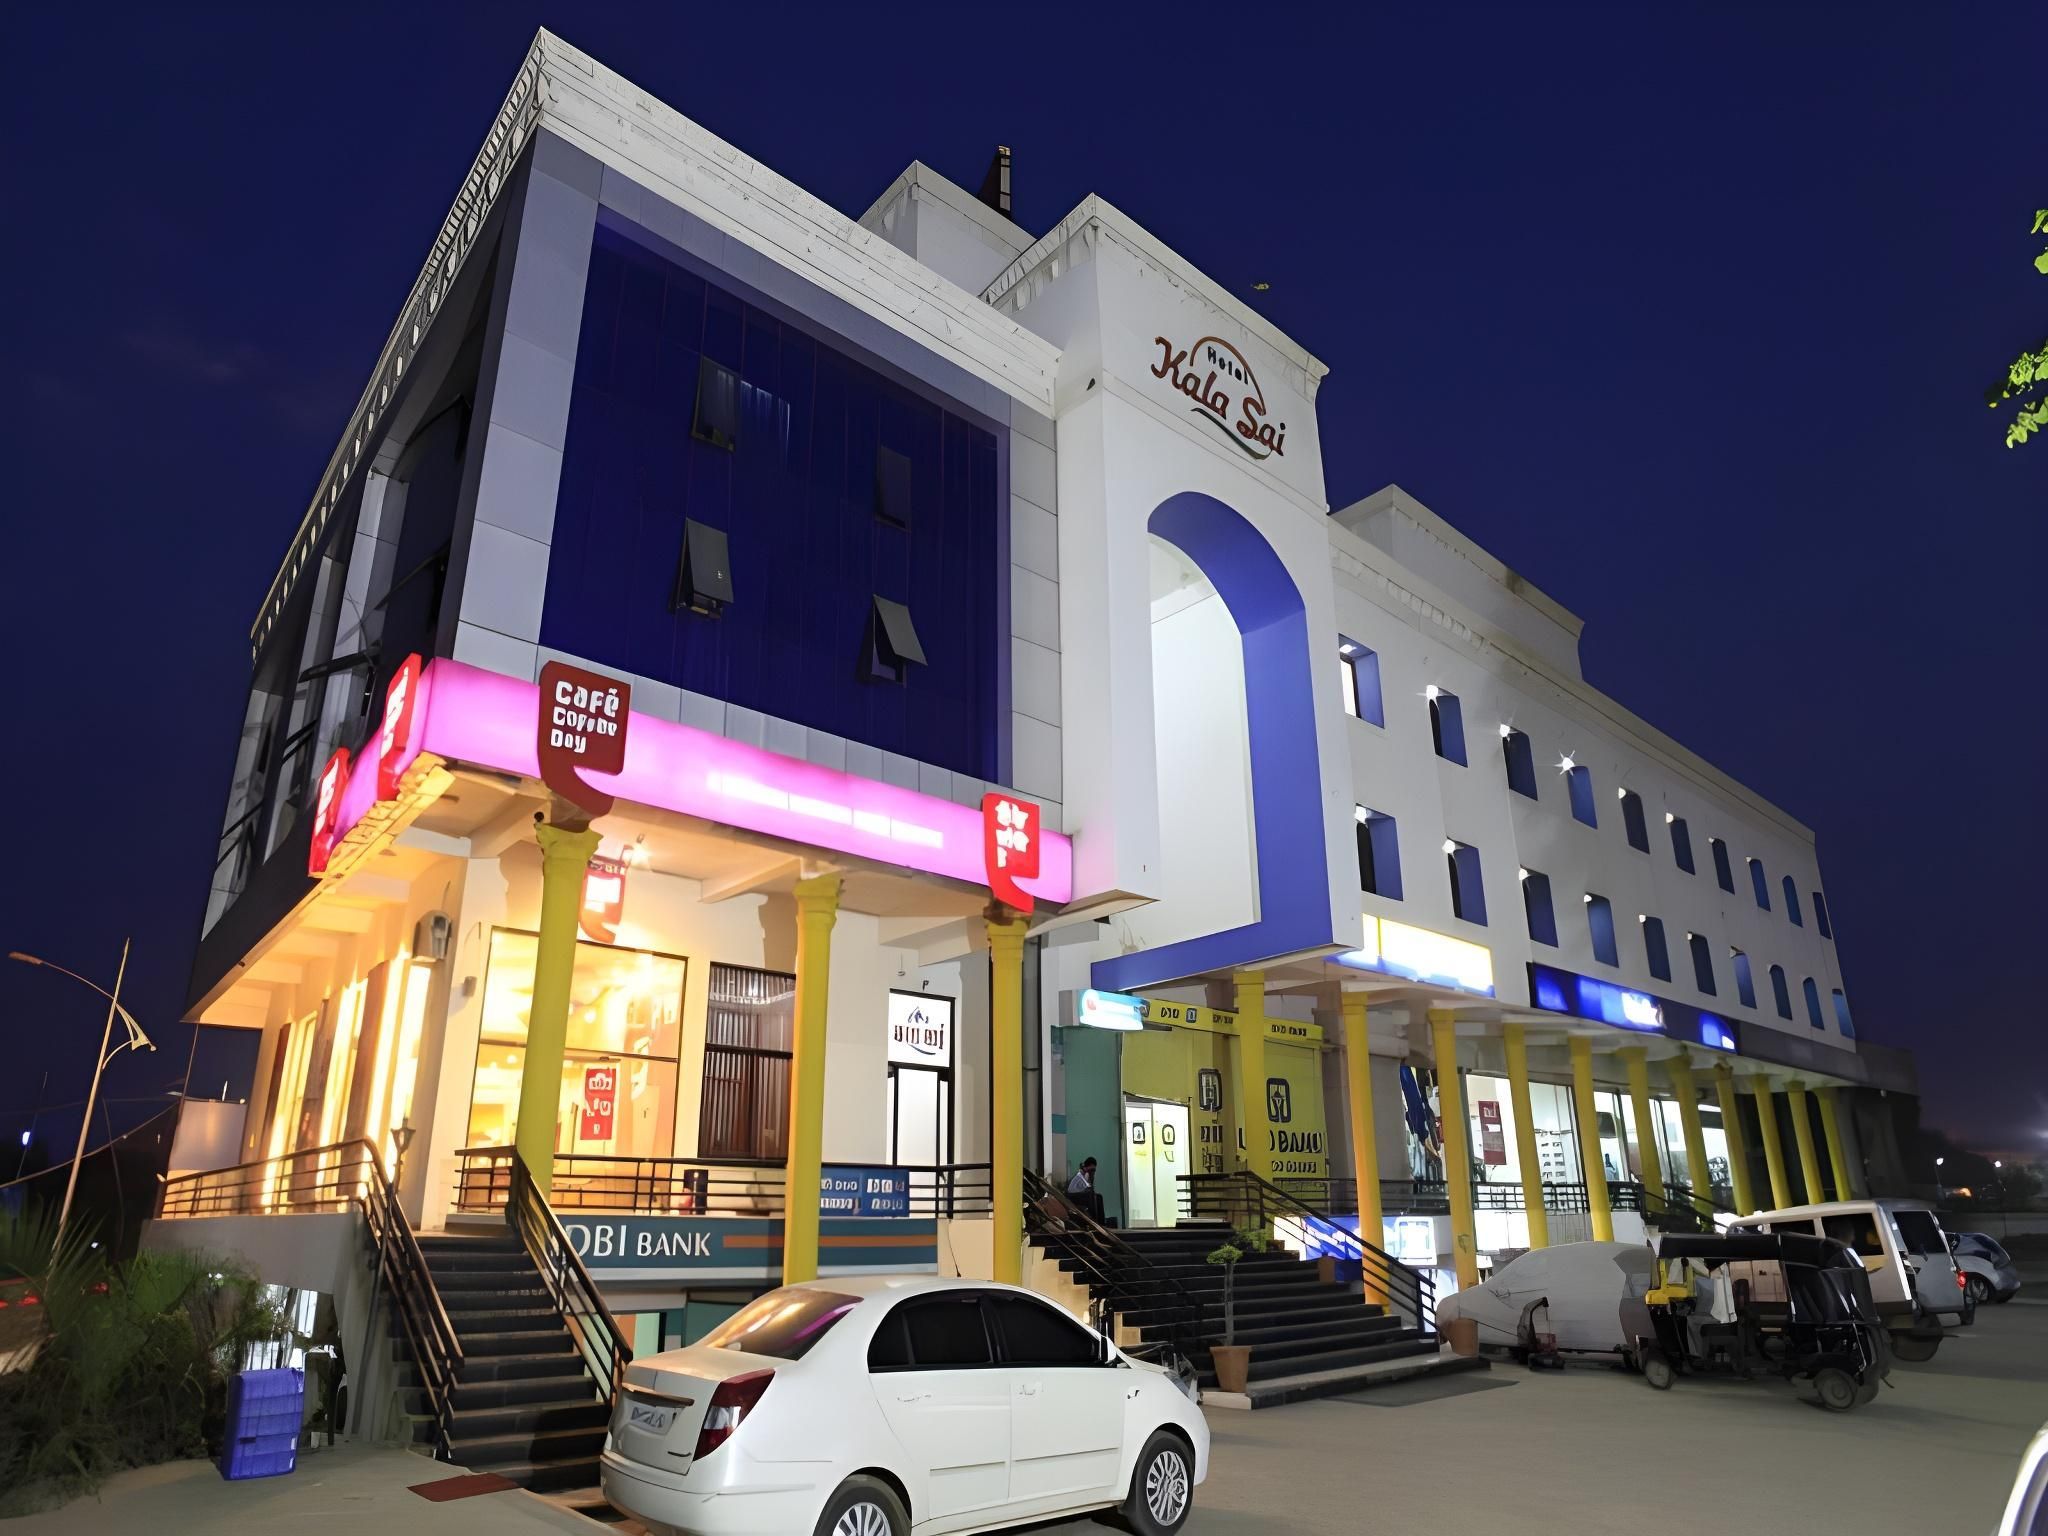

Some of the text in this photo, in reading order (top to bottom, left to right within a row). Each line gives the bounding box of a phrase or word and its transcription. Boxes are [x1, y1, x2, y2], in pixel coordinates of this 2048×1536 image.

[1151, 336, 1286, 457] Kala Sai
[559, 1224, 711, 1257] DBI BANK
